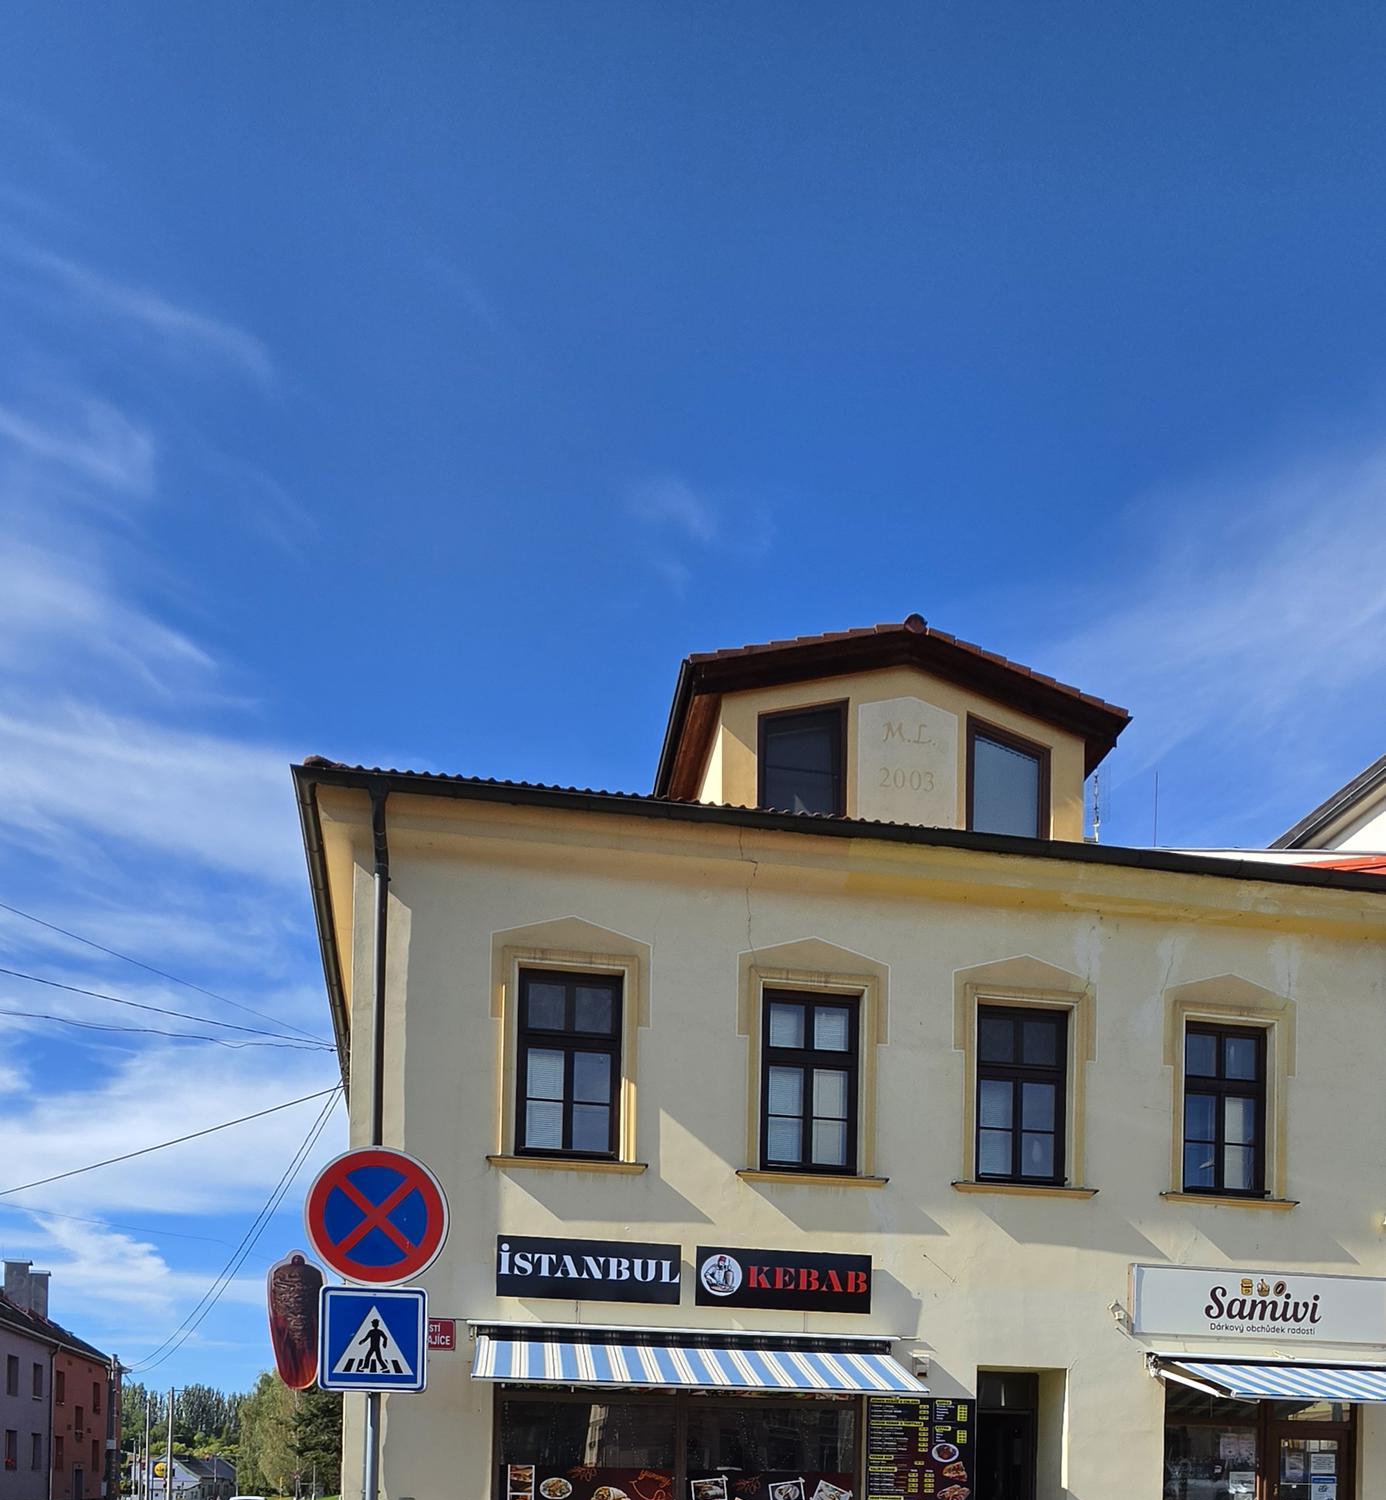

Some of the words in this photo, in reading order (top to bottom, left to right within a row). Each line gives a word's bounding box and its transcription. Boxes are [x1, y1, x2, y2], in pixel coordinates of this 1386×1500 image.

[879, 767, 934, 792] 2003
[499, 1243, 680, 1283] İSTANBUL
[748, 1265, 868, 1293] KEBAB
[1204, 1286, 1321, 1324] Samivi
[428, 1333, 451, 1345] AJÍCE
[429, 1322, 441, 1332] STÍ
[1210, 1323, 1244, 1333] Dárkový
[1246, 1324, 1286, 1333] obchůdek
